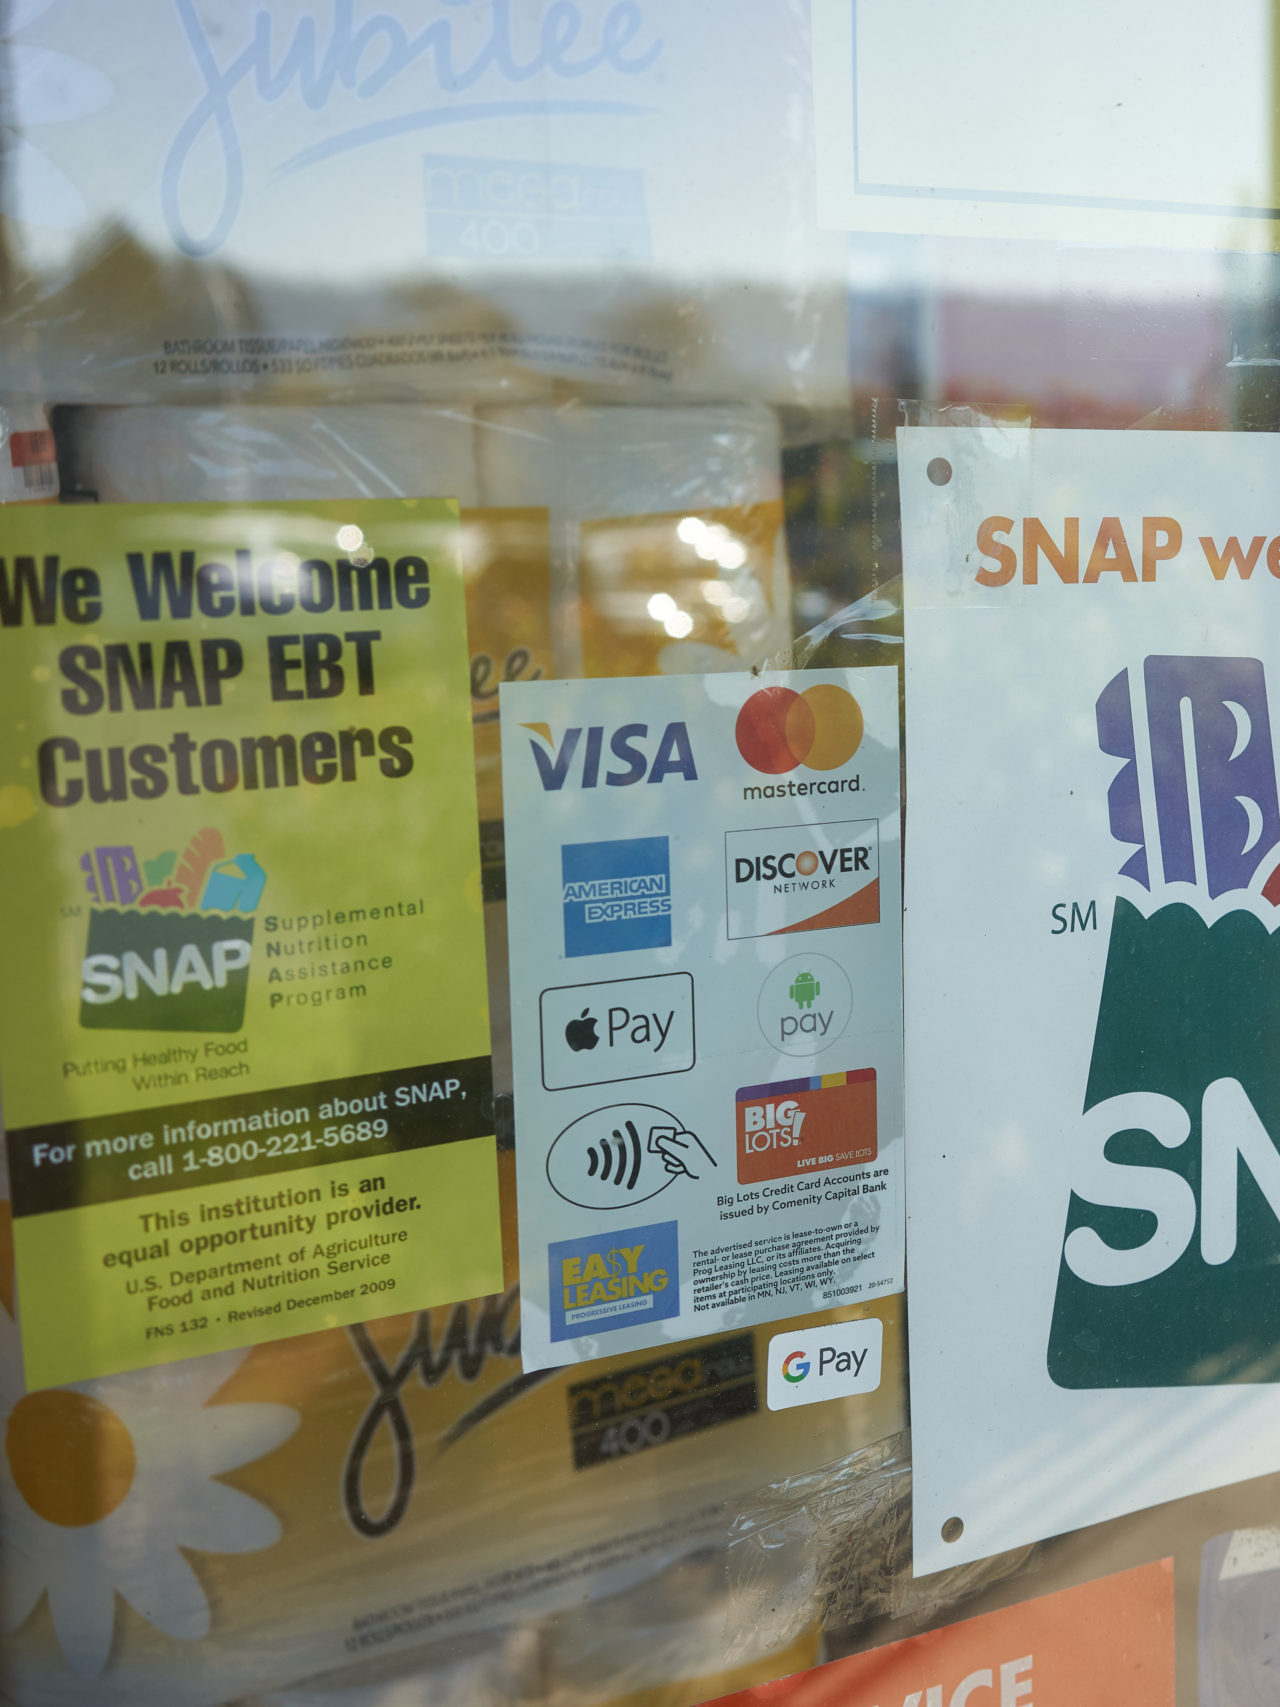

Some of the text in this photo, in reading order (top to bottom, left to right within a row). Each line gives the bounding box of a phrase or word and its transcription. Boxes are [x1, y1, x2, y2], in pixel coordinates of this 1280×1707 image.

[458, 220, 541, 256] 400
[164, 339, 236, 355] BATHROOM
[153, 361, 167, 374] 12
[974, 515, 1183, 587] SNAP
[0, 549, 431, 628] We Welcome
[58, 630, 383, 716] SNAP EBT
[37, 725, 414, 807] Customers
[517, 721, 698, 791] VISA
[735, 846, 871, 883] DISCOVER
[563, 876, 665, 900] AMERICAN
[774, 879, 836, 894] NETWORK
[265, 898, 424, 933] Supplemental
[587, 898, 672, 922] EXPRESS
[1050, 900, 1098, 934] SM
[266, 932, 368, 959] Nutrition
[81, 938, 252, 1005] SNAP
[268, 955, 393, 984] Assistance
[269, 984, 367, 1008] Program
[608, 1006, 675, 1052] Pay
[781, 1010, 834, 1041] pay
[63, 1038, 248, 1079] Putting Healthy Food
[131, 1062, 250, 1092] Within Reach
[32, 1078, 468, 1168] For more information about SNAP,
[744, 1100, 800, 1132] BIG
[745, 1111, 806, 1154] LOTS!
[128, 1118, 388, 1181] call 1-800-221-5689
[797, 1147, 872, 1168] LIVE BIG SAVE LOTS
[139, 1176, 386, 1234] This institution is an
[717, 1168, 889, 1207] Big Lots Credit Card Accounts are
[719, 1181, 887, 1221] issued by Comenity Capital Bank
[102, 1194, 422, 1269] equal opportunity provider.
[693, 1224, 842, 1259] The advertised service is lease-to-own
[693, 1224, 880, 1268] rental- lease purchase agreement provided by
[126, 1229, 409, 1295] U.S. Department of Agriculture
[693, 1237, 862, 1277] Prog Leasing its affiliates. Acquiring
[693, 1246, 855, 1286] ownership by leasing costs more than the
[693, 1251, 875, 1295] retailer's cash price. Leasing available select
[147, 1252, 391, 1312] Food and Nutrition Service
[563, 1269, 669, 1310] LEASING
[693, 1269, 836, 1304] items participating locations only.
[693, 1276, 836, 1312] Not available MN, NJ, VT, WI, WY.
[822, 1284, 862, 1299] 851003921
[145, 1278, 396, 1340] FNS 132 Revised December 2009
[571, 1299, 648, 1320] PROGRESSIVE LEASING
[818, 1346, 869, 1377] Pay
[599, 1409, 671, 1456] 400
